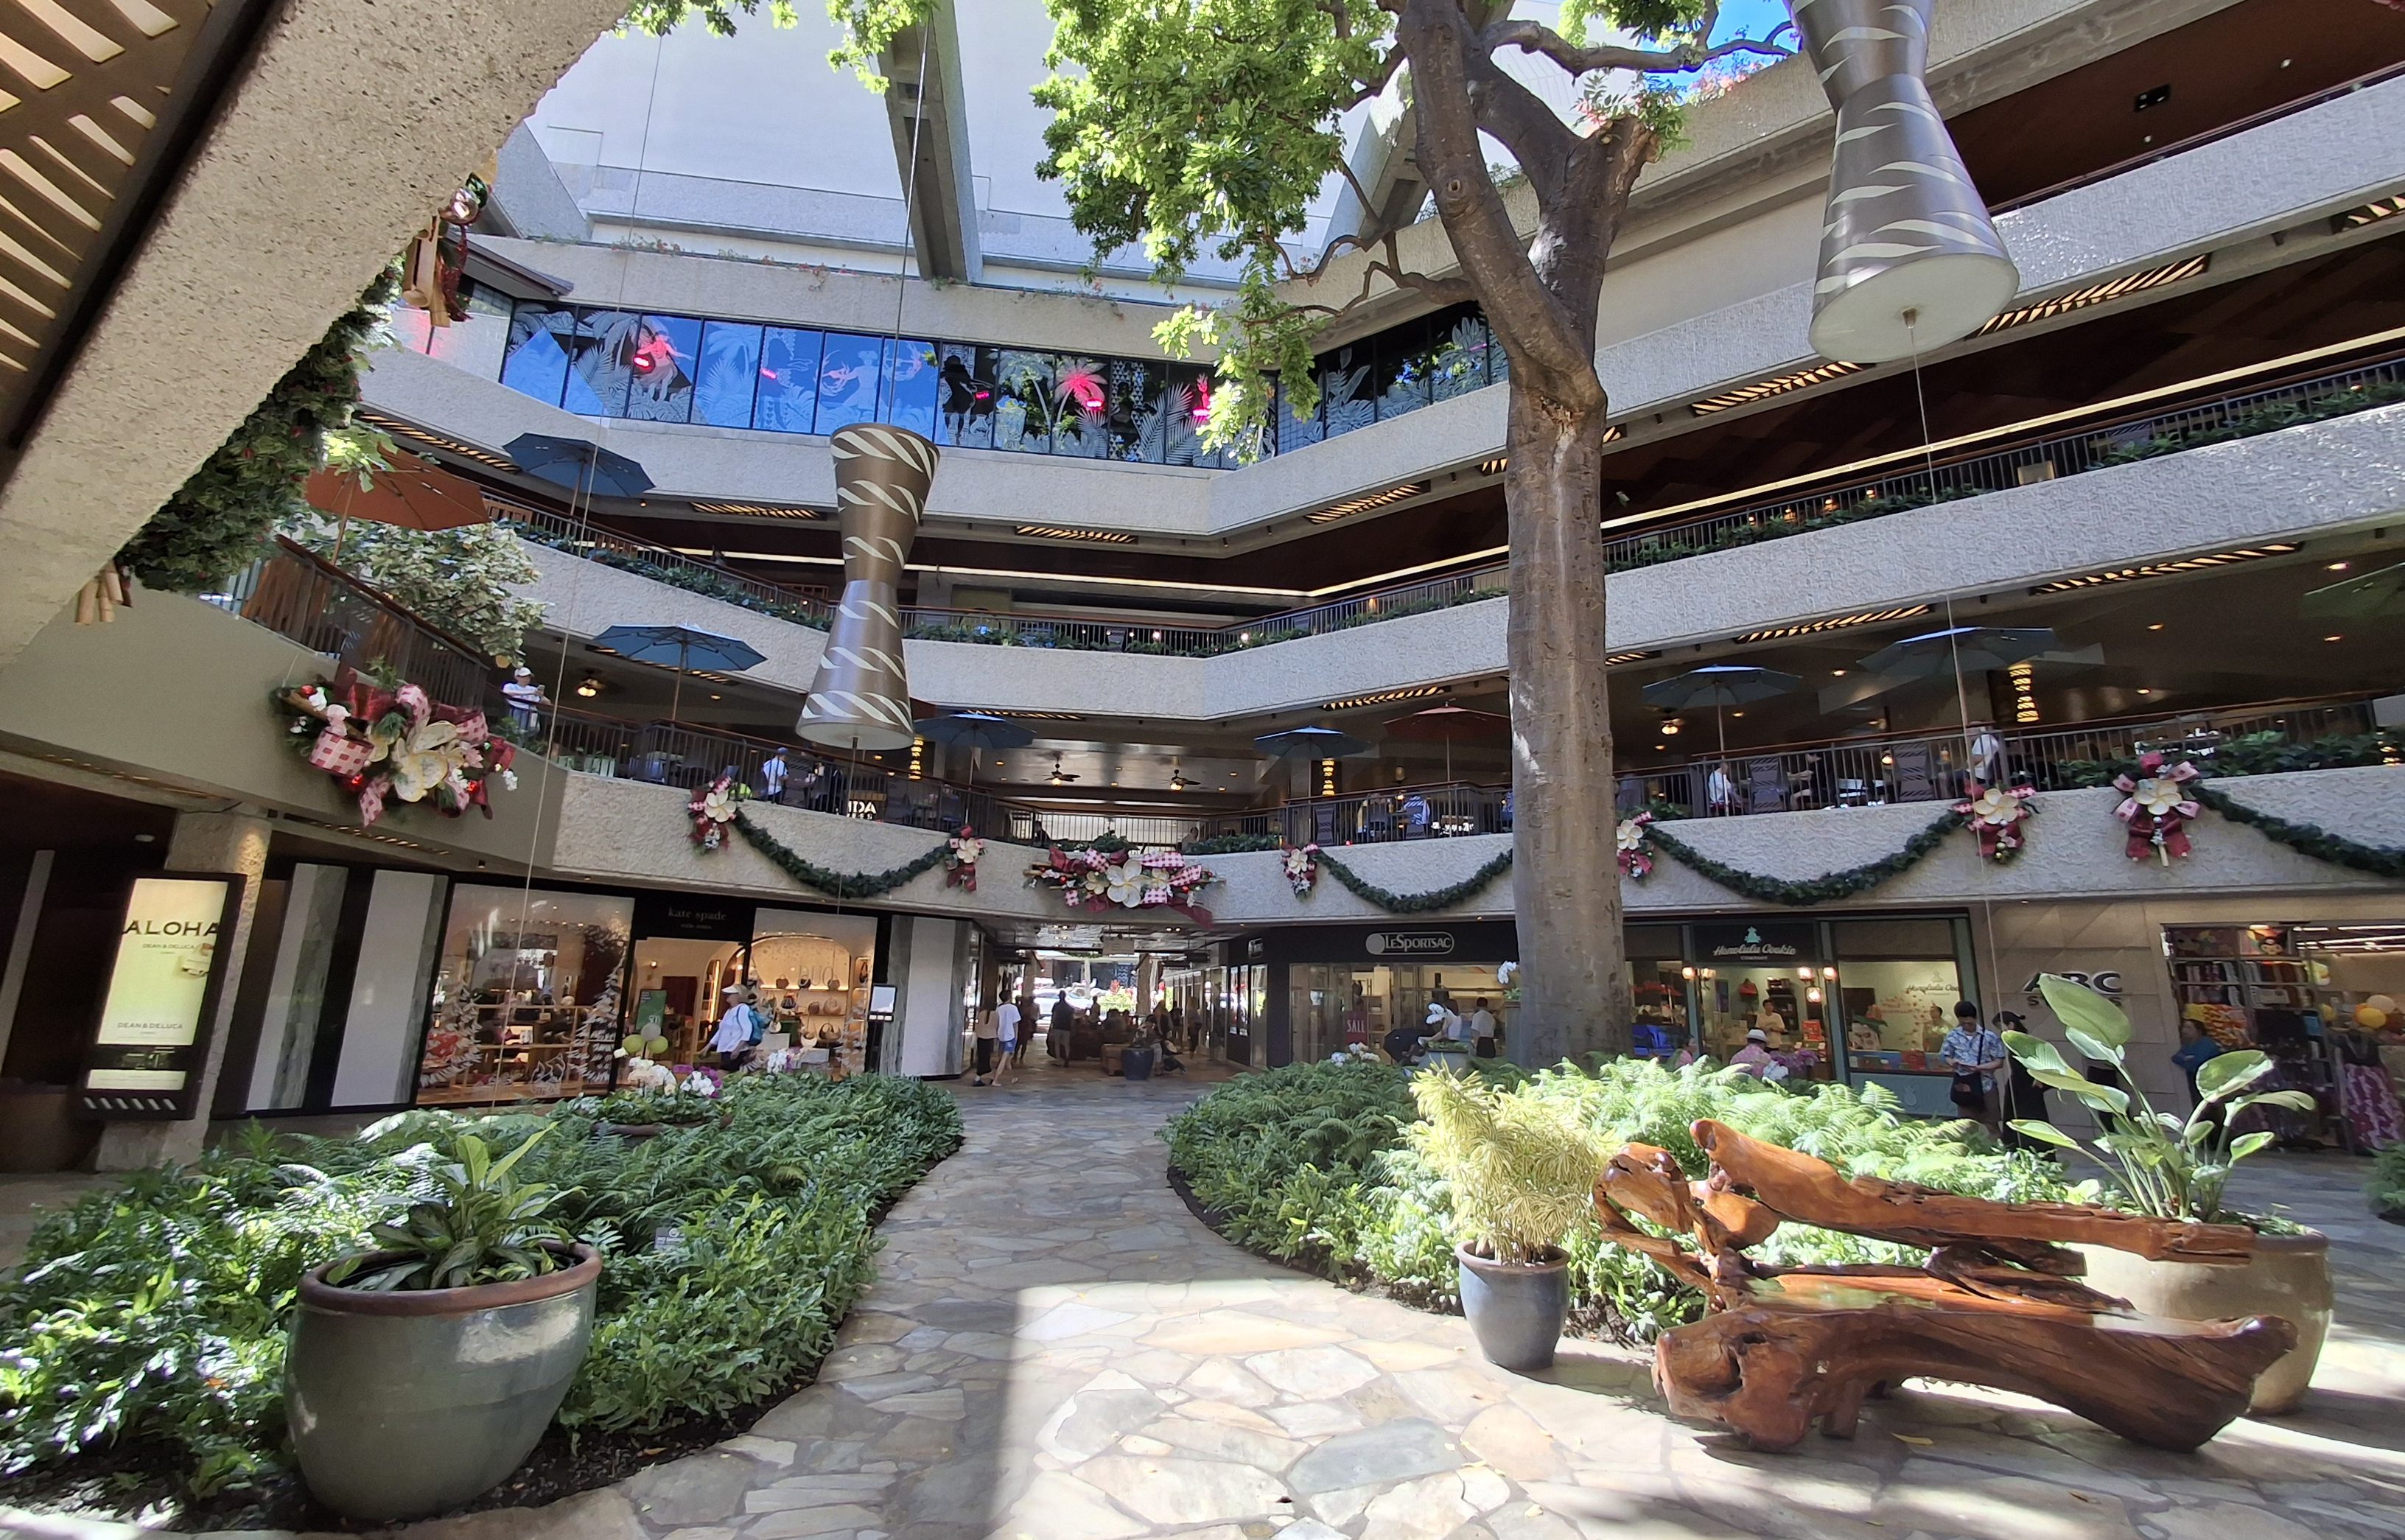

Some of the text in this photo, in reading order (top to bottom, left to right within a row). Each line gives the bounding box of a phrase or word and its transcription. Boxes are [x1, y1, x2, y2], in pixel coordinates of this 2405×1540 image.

[668, 907, 727, 922] kate spade
[122, 920, 219, 937] ALOHA
[1712, 943, 1796, 956] Honolulu Cookie
